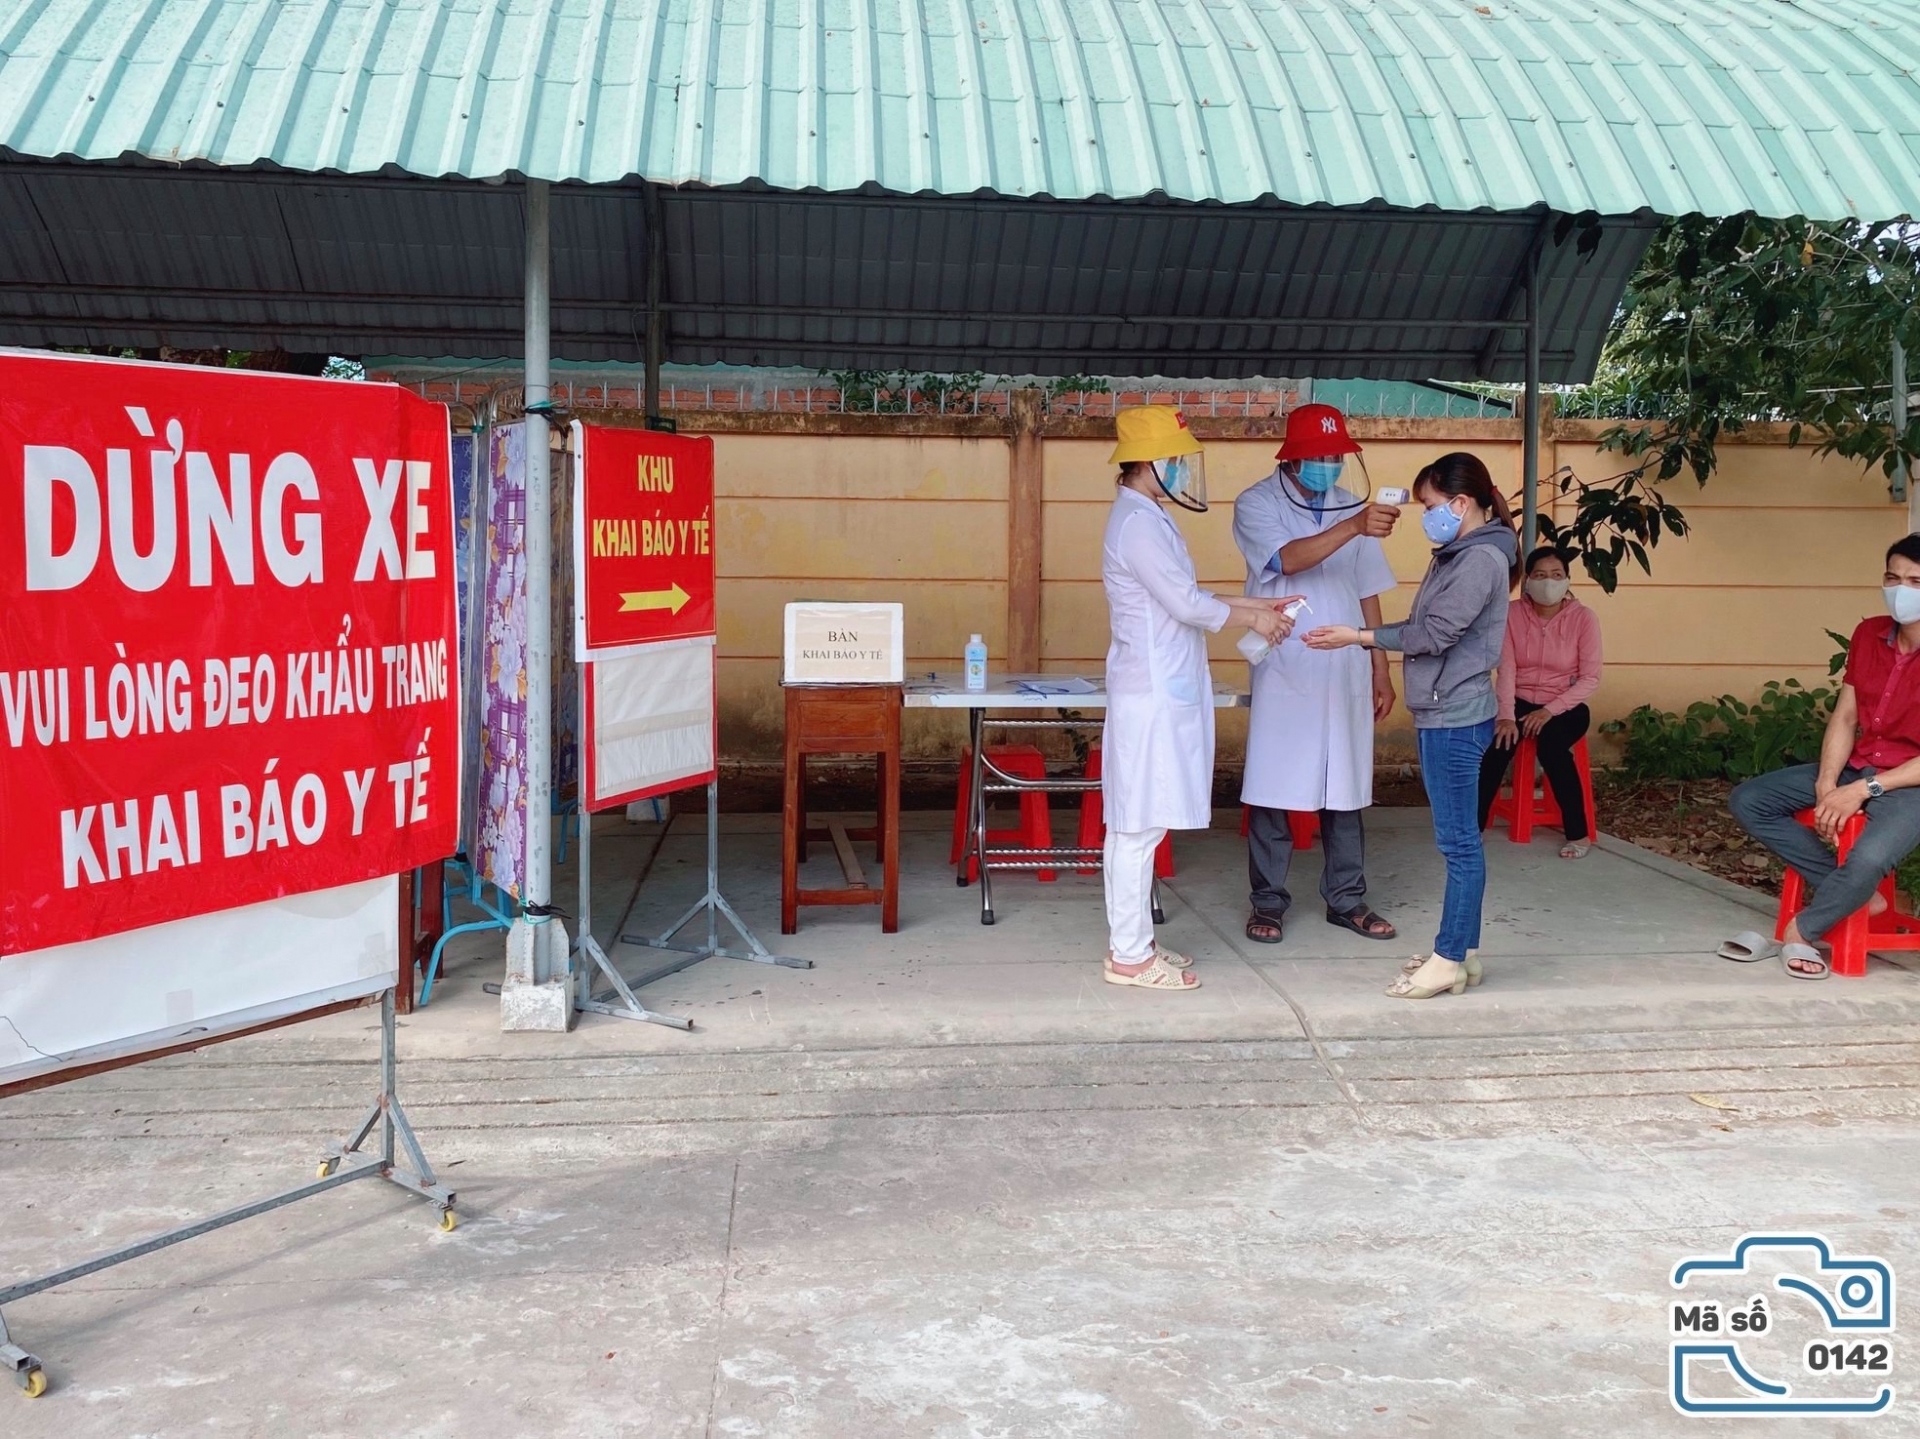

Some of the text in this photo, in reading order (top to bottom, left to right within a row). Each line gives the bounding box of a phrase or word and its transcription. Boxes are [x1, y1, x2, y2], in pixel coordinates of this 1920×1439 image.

[1321, 416, 1338, 433] NY
[23, 405, 437, 593] DỪNG XE
[638, 454, 674, 494] KHU
[593, 504, 710, 558] KHAI BÁO Y TẾ
[0, 613, 448, 748] VUI LÒNG ĐEO KHẨU TRANG
[803, 649, 830, 660] KHAI
[859, 650, 867, 660] Y
[60, 726, 431, 889] KHAI BÁO Y TẾ
